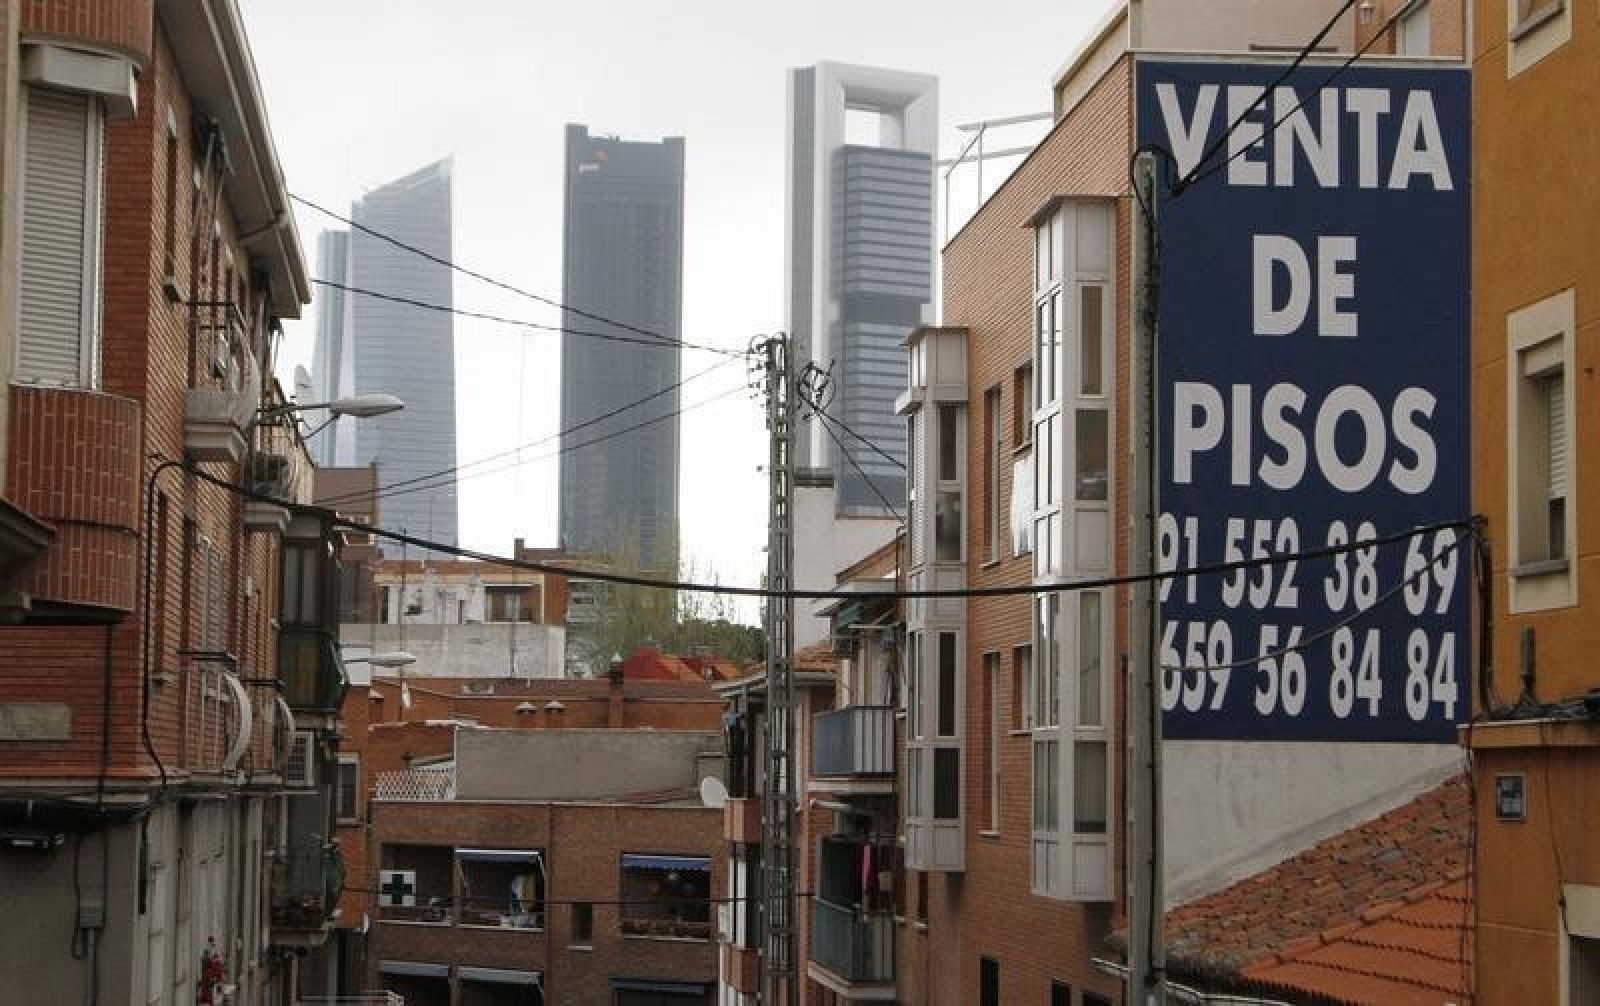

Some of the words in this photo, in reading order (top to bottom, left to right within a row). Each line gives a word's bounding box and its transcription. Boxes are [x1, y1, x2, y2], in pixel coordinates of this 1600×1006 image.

[1156, 83, 1453, 190] VENTA
[1253, 234, 1358, 337] DE
[1172, 381, 1437, 494] PISOS
[1159, 512, 1198, 603] 91
[1222, 516, 1299, 608] 552
[1324, 519, 1379, 611] 38
[1404, 525, 1458, 616] 69
[1160, 619, 1232, 712] 659
[1255, 624, 1306, 717] 56
[1329, 626, 1382, 718] 84
[1405, 628, 1457, 721] 84
